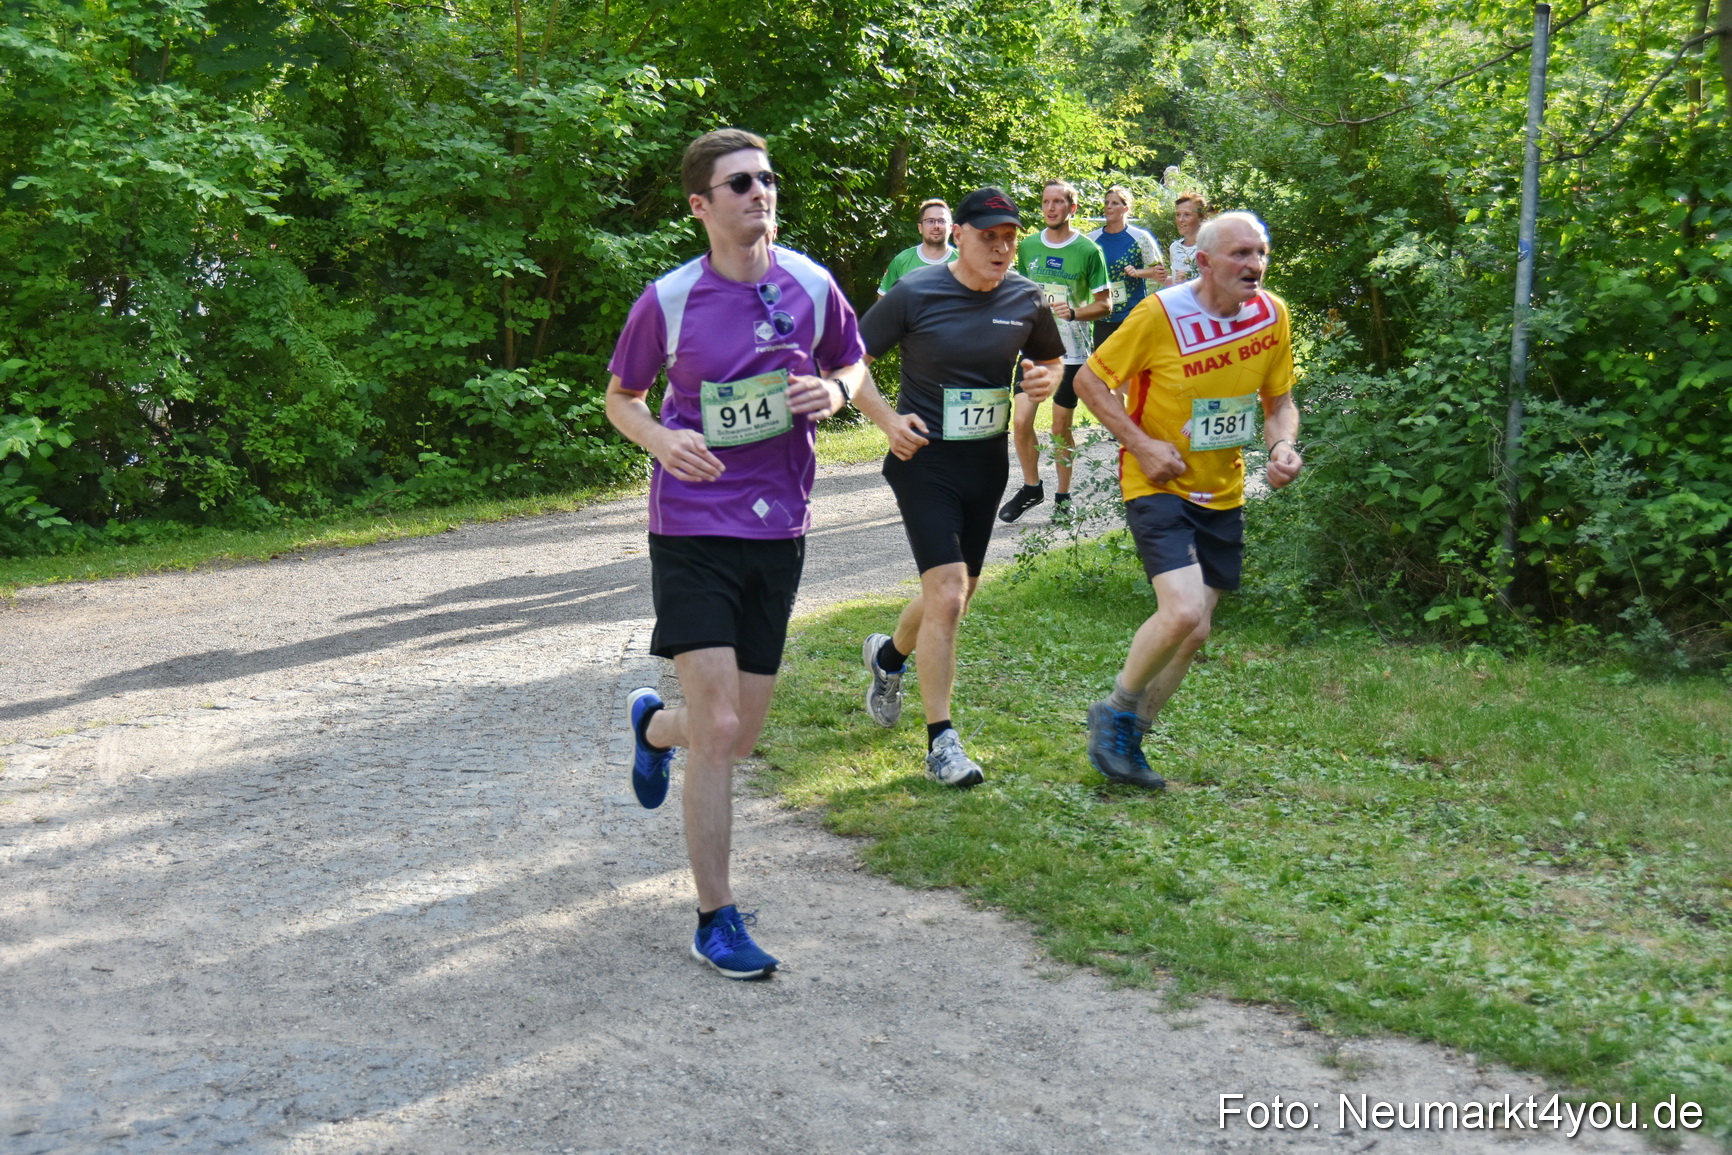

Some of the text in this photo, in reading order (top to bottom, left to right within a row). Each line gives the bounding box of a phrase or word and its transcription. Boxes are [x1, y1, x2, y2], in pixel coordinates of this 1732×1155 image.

[1182, 331, 1279, 378] MAX BÖGL
[720, 398, 772, 429] 914
[960, 406, 995, 426] 171
[1200, 413, 1246, 436] 1581
